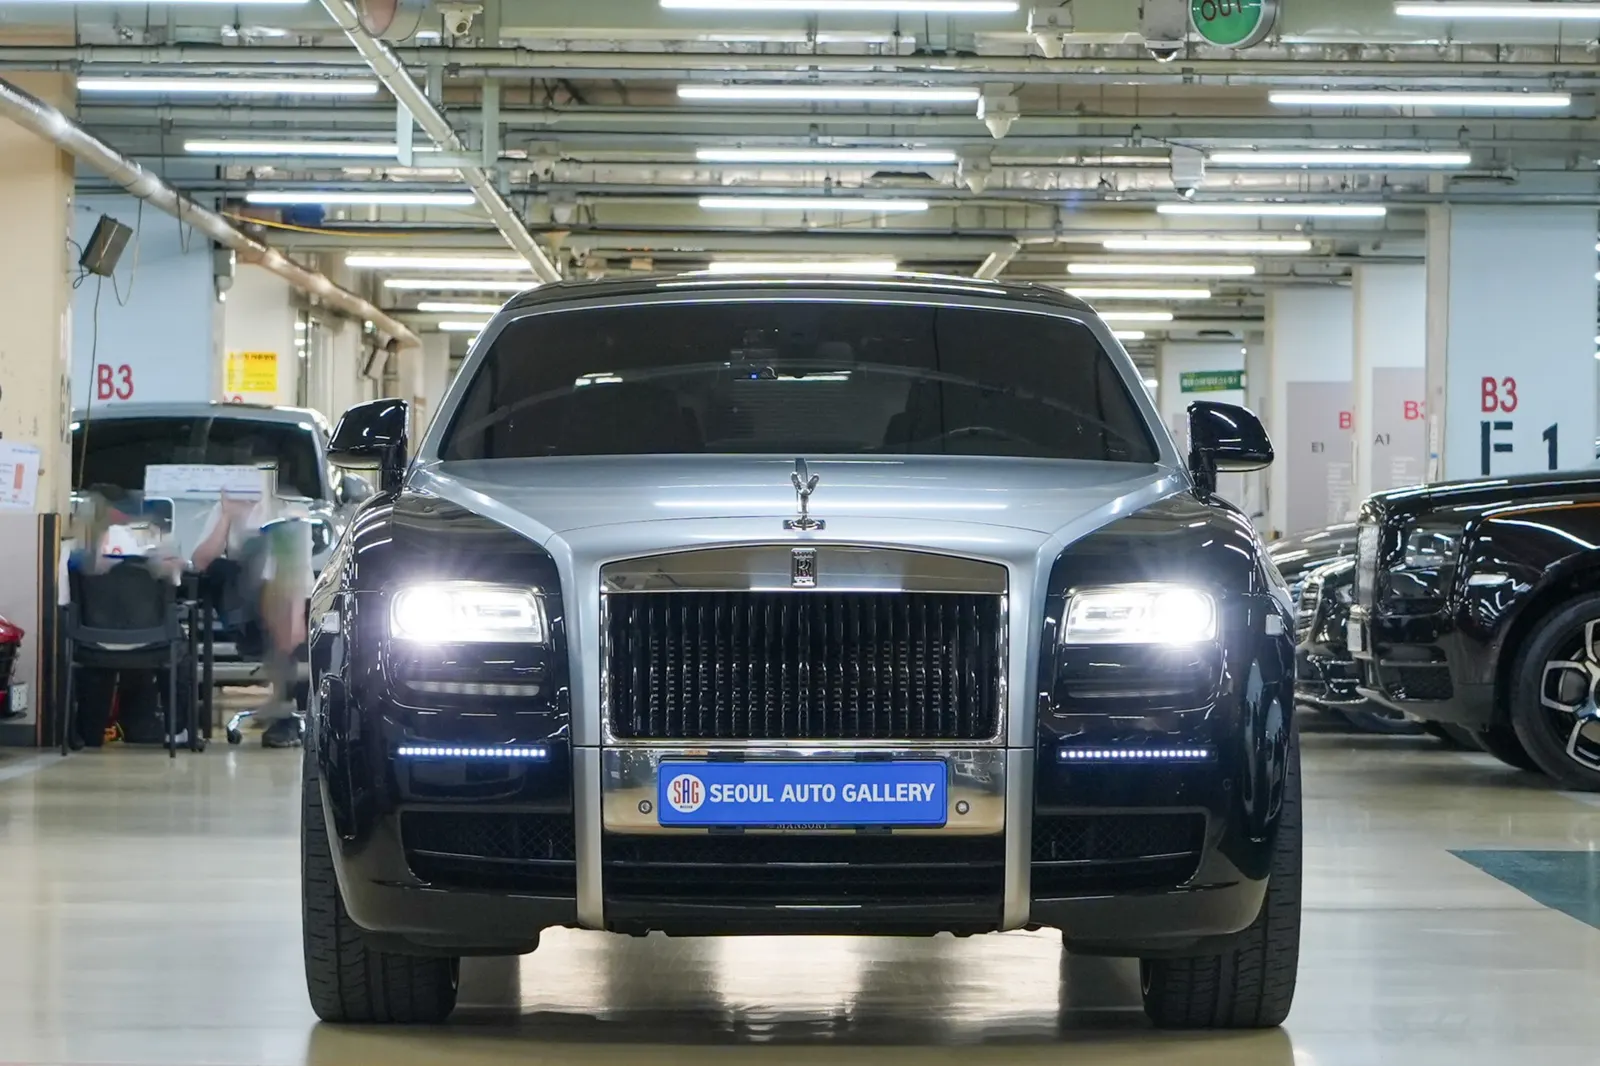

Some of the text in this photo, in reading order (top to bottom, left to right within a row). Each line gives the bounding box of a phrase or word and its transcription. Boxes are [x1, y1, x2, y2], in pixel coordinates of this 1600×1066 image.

[97, 363, 134, 401] B3
[1481, 376, 1518, 413] B3
[1311, 441, 1325, 454] E1
[1374, 433, 1391, 446] A1
[673, 778, 699, 804] SAG
[709, 783, 935, 803] SEOUL AUTO GALLERY
